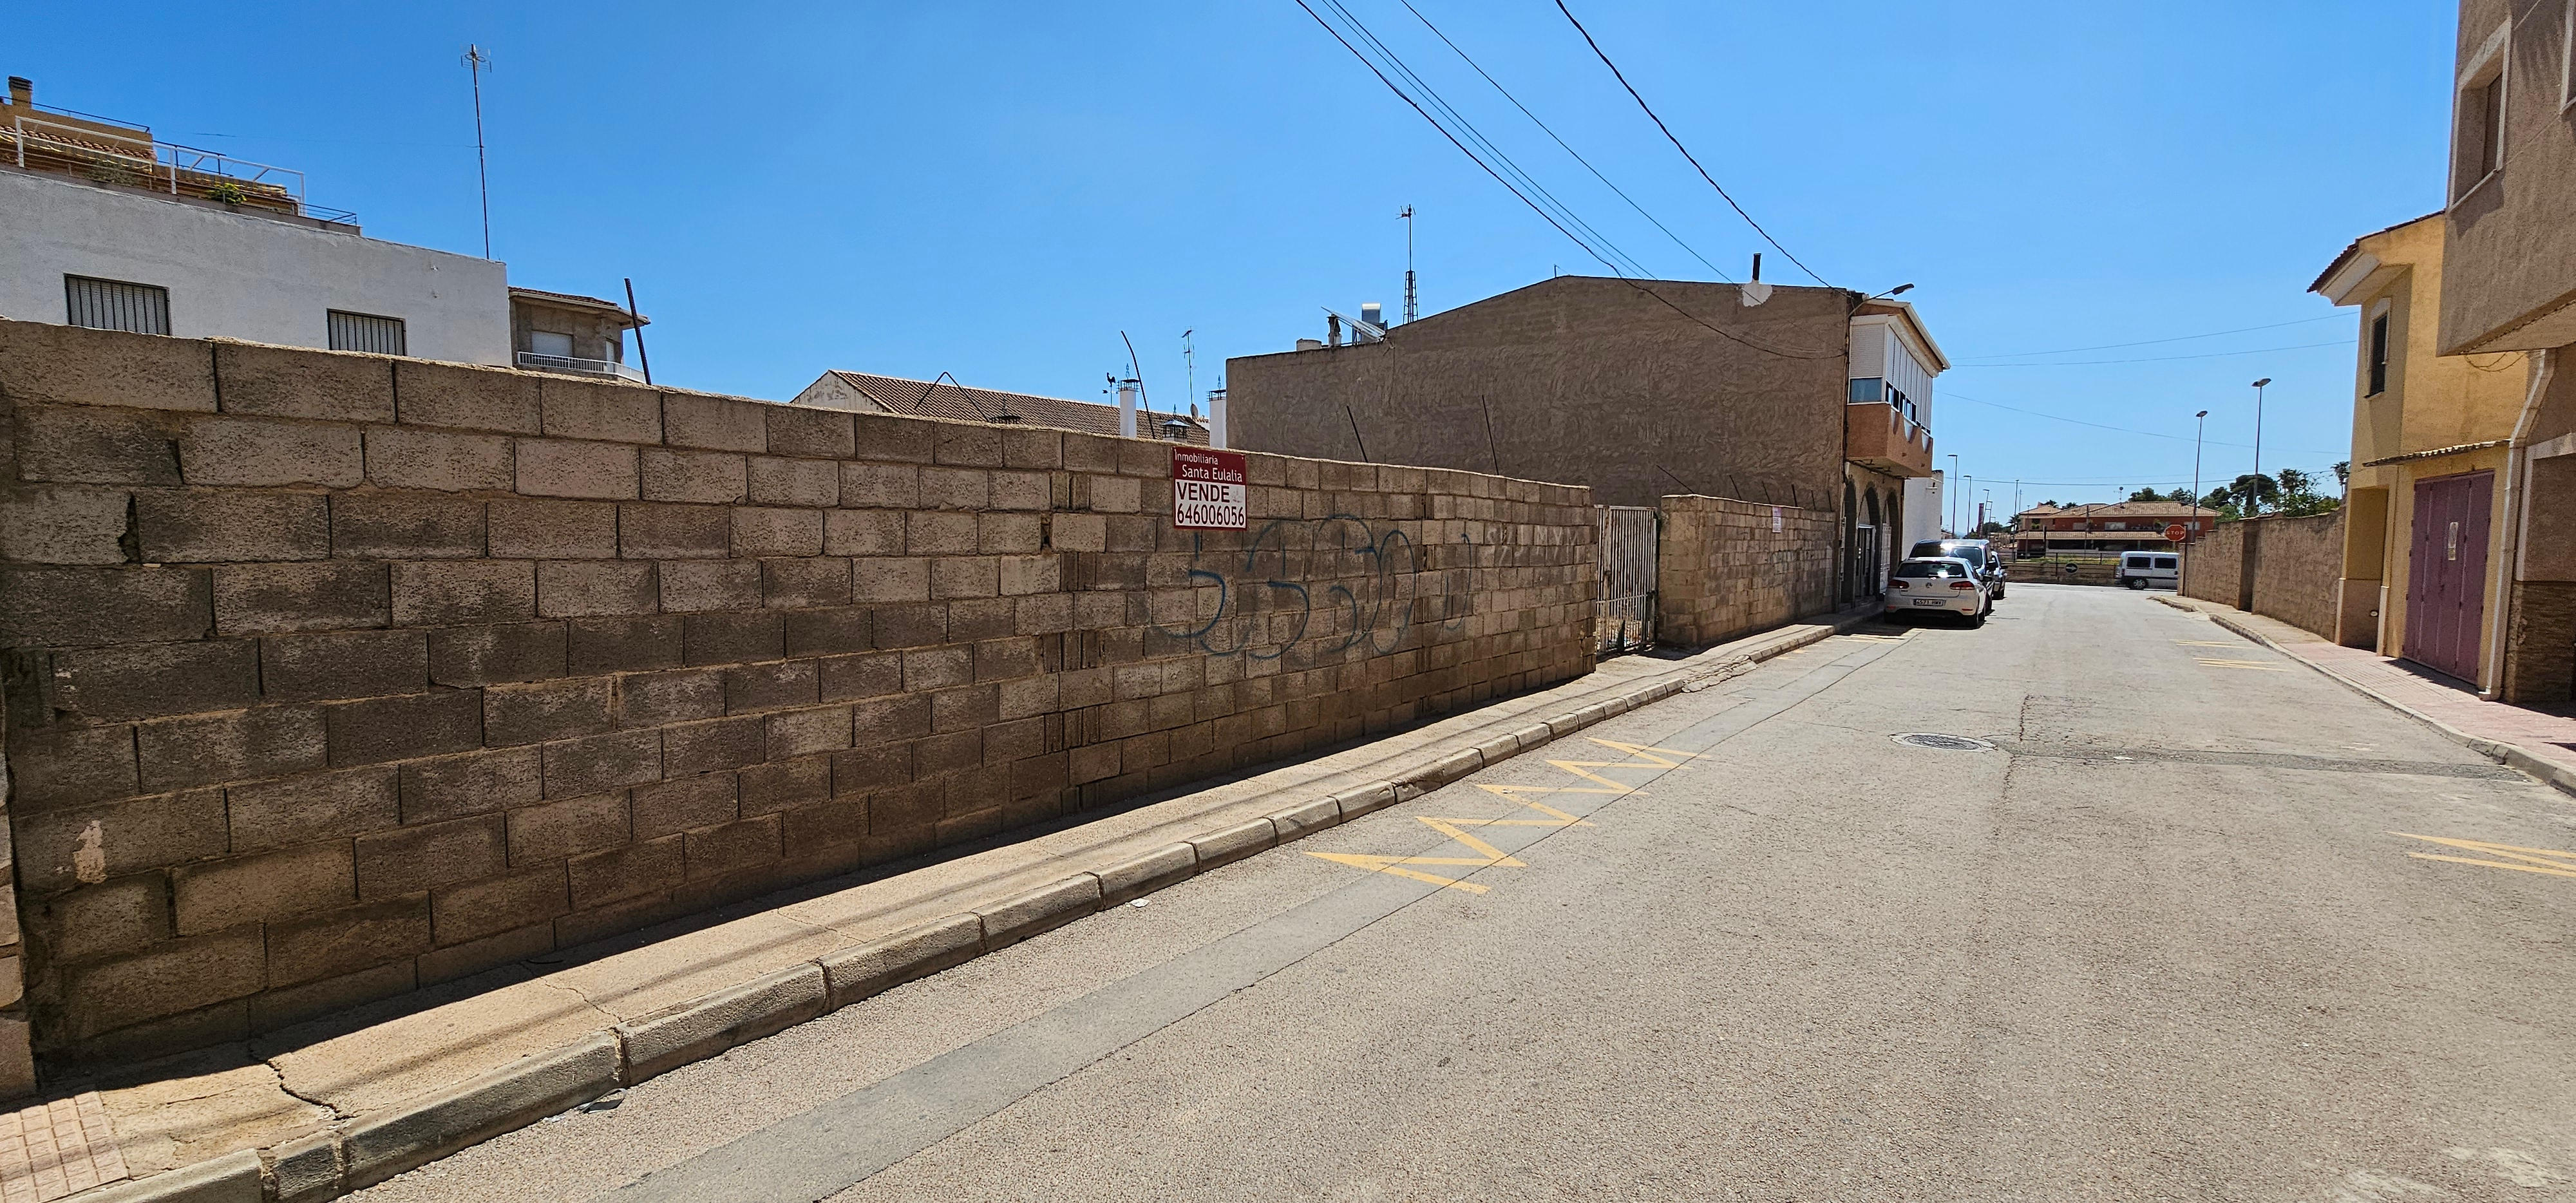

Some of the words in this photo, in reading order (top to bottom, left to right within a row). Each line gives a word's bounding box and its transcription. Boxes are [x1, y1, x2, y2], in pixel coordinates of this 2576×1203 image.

[1174, 449, 1218, 465] Inmobiliaria
[1182, 464, 1209, 479] Santa
[1212, 468, 1243, 482] Eulalia
[1177, 482, 1230, 503] VENDE
[1177, 503, 1244, 526] 646006056
